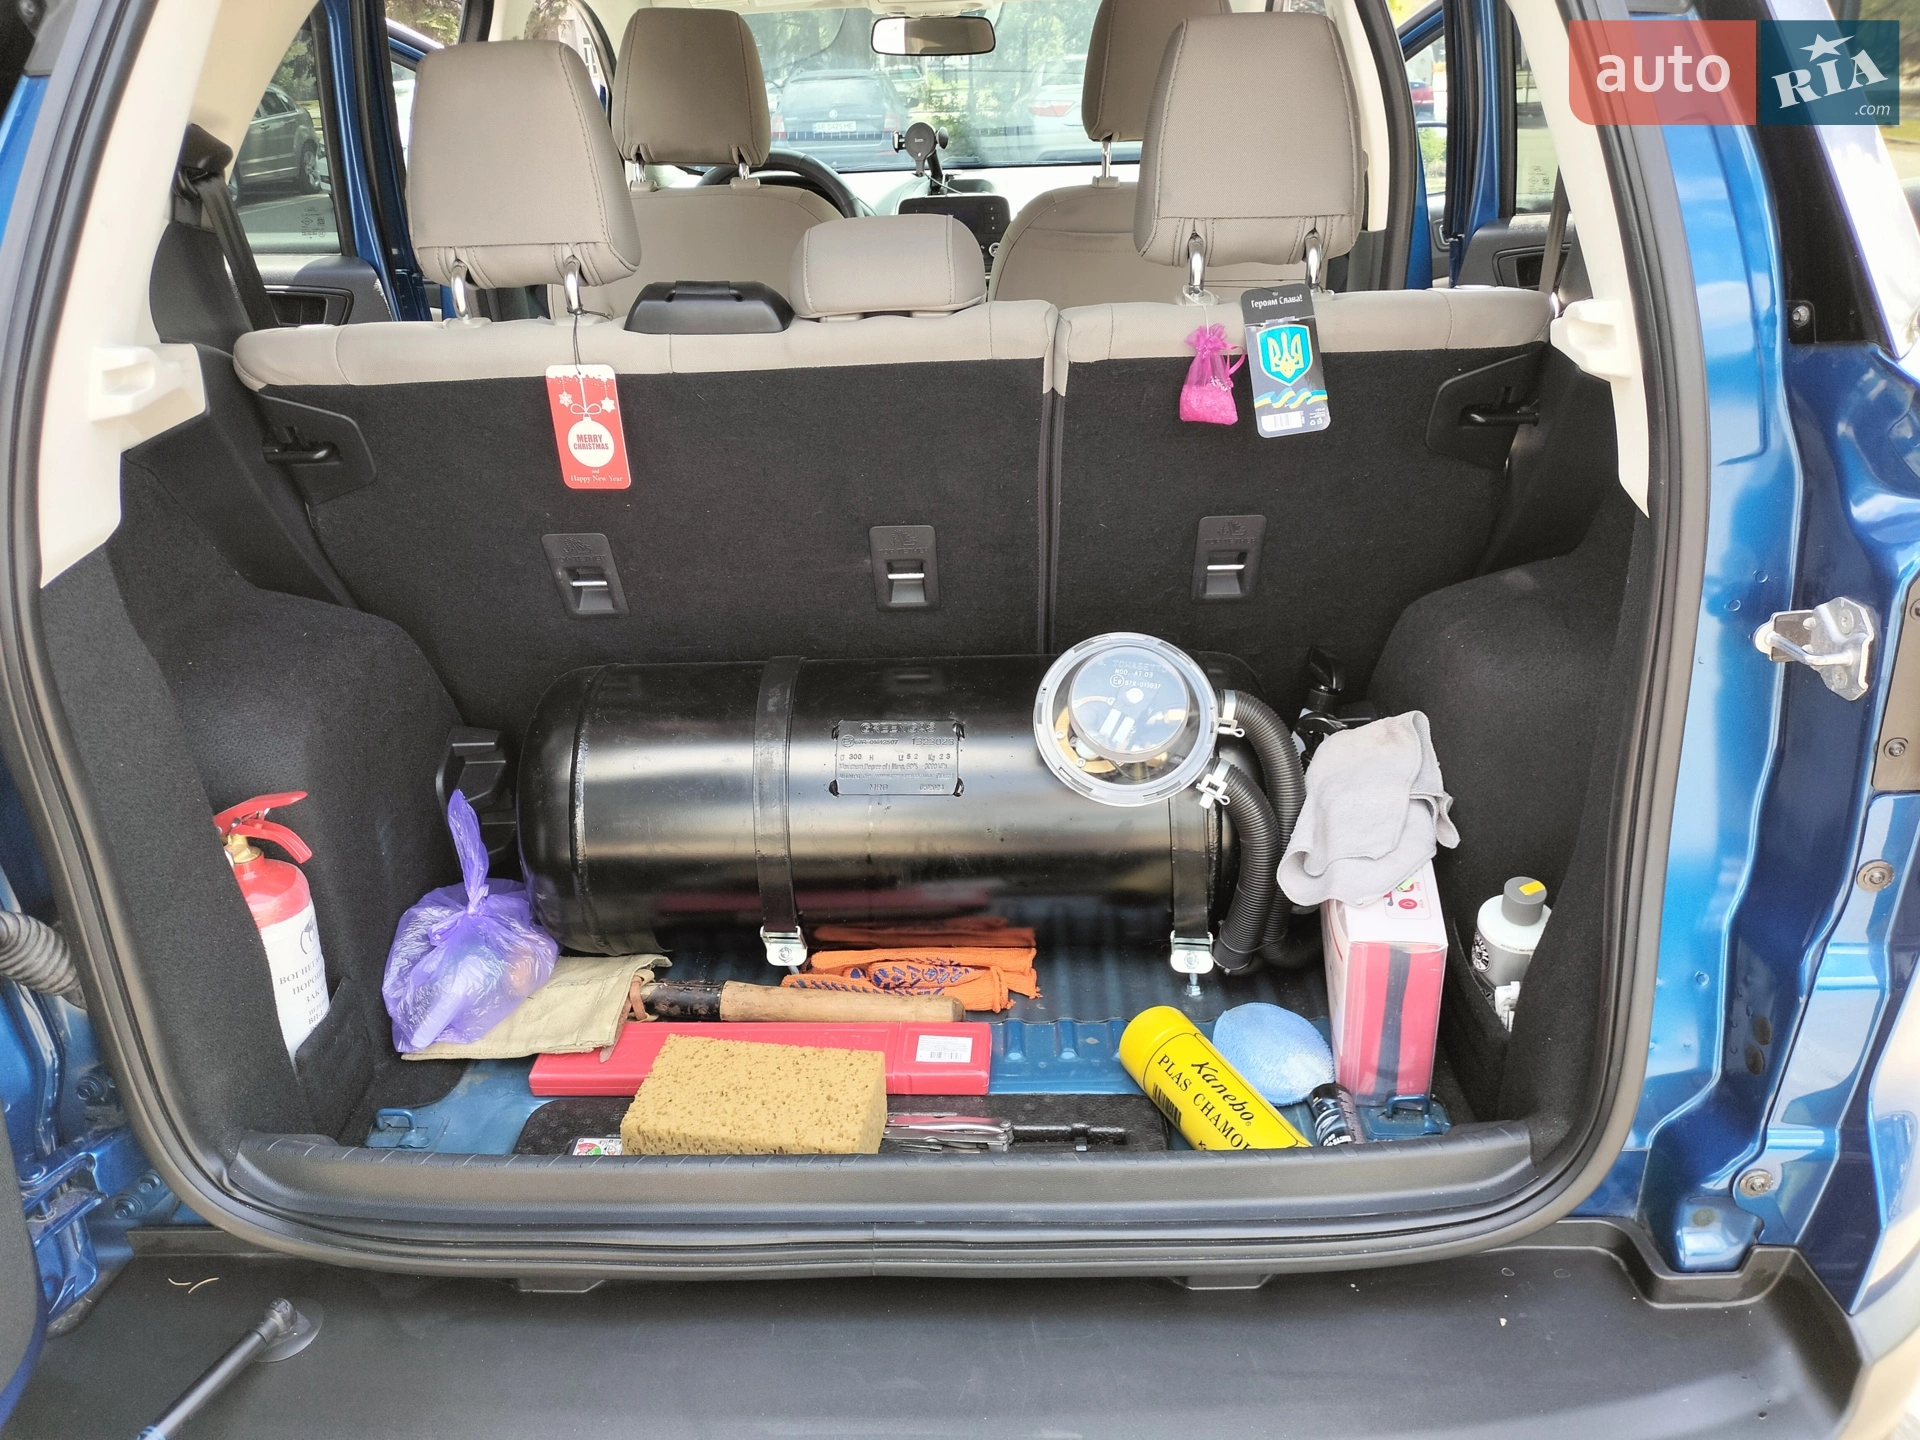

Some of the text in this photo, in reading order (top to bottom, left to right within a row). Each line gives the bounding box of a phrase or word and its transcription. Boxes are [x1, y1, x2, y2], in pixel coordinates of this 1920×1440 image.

[1251, 293, 1303, 310] Героям Слава!
[576, 434, 603, 443] MERRY
[570, 474, 624, 484] Happy New Year
[1157, 1053, 1193, 1092] PLAS
[1191, 1061, 1255, 1123] Kanebo
